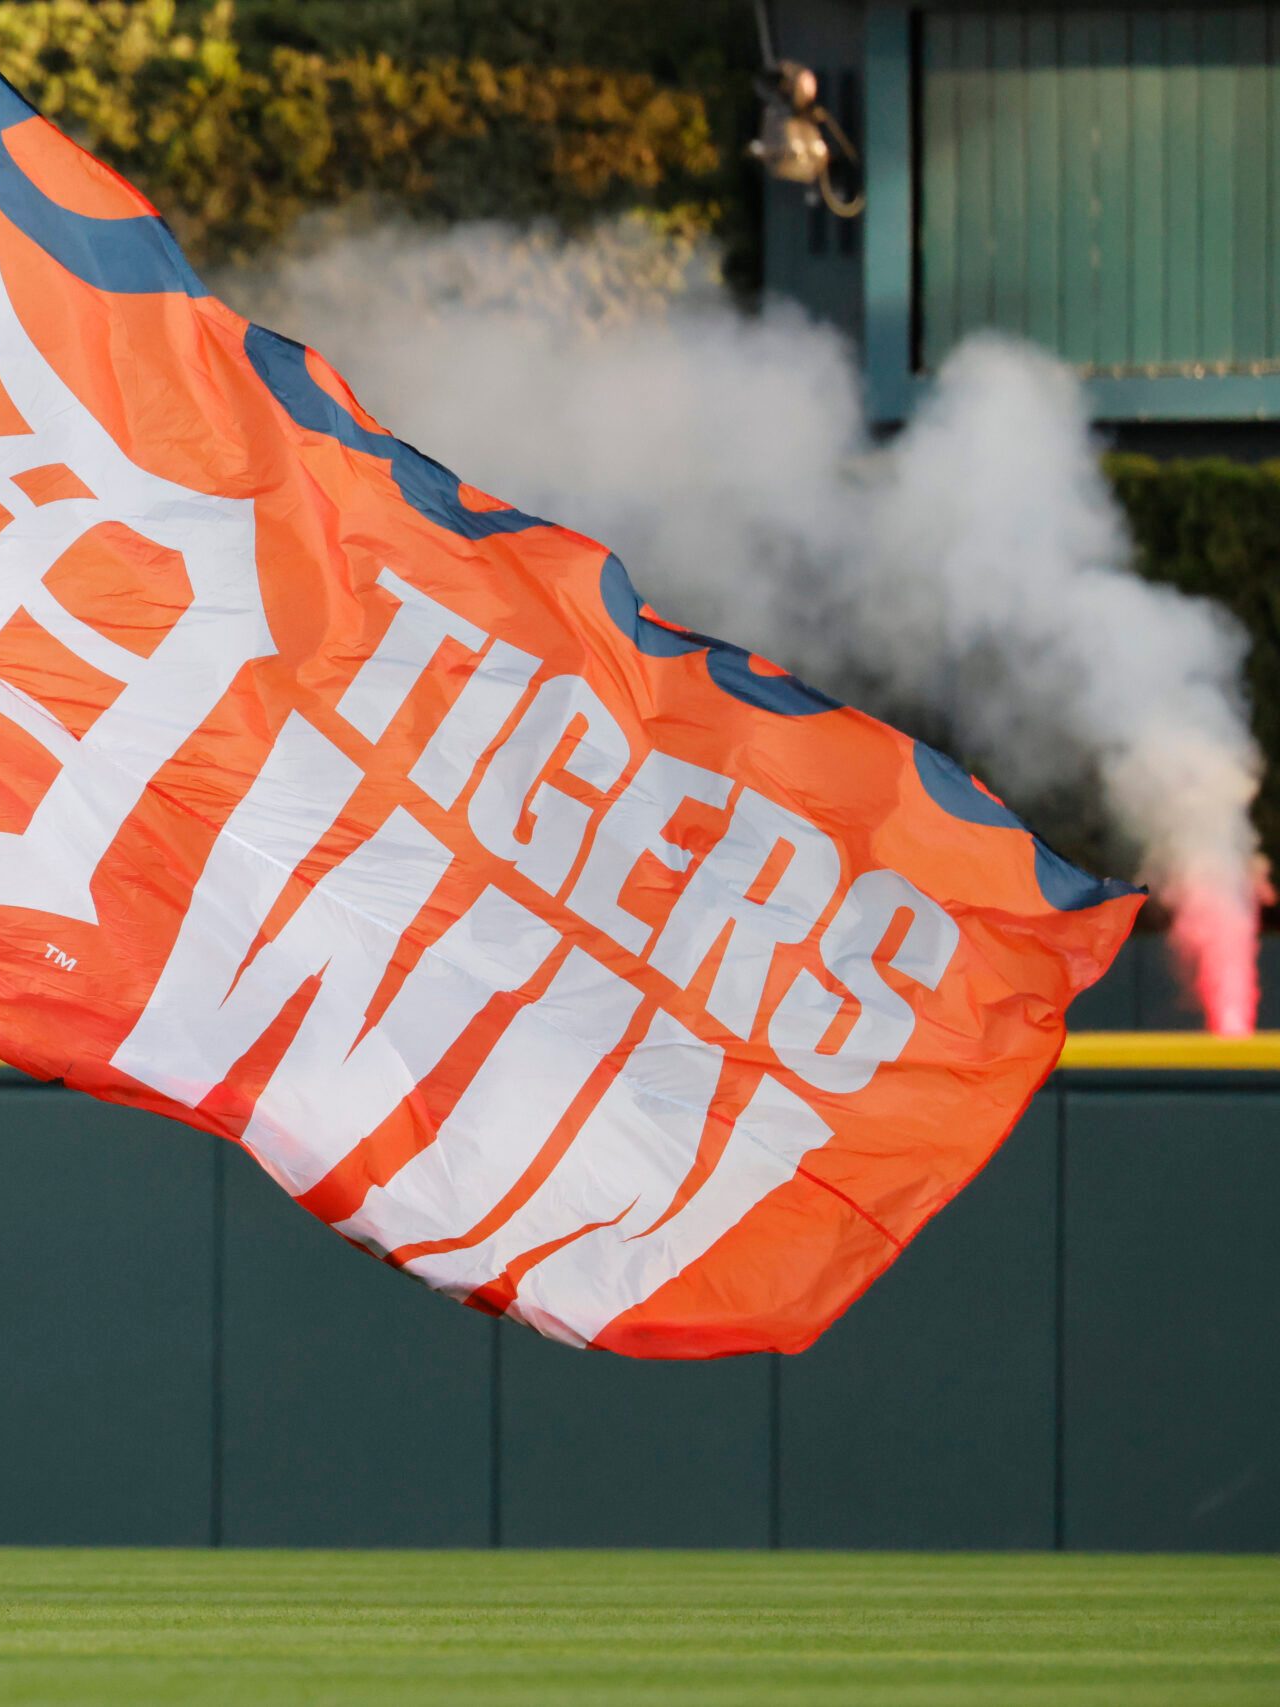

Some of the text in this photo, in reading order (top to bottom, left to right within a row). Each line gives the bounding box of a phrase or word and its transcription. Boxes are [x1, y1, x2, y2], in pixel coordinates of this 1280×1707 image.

[45, 943, 77, 971] TM
[110, 709, 835, 1348] WIN
[334, 566, 960, 1094] TIGERS
